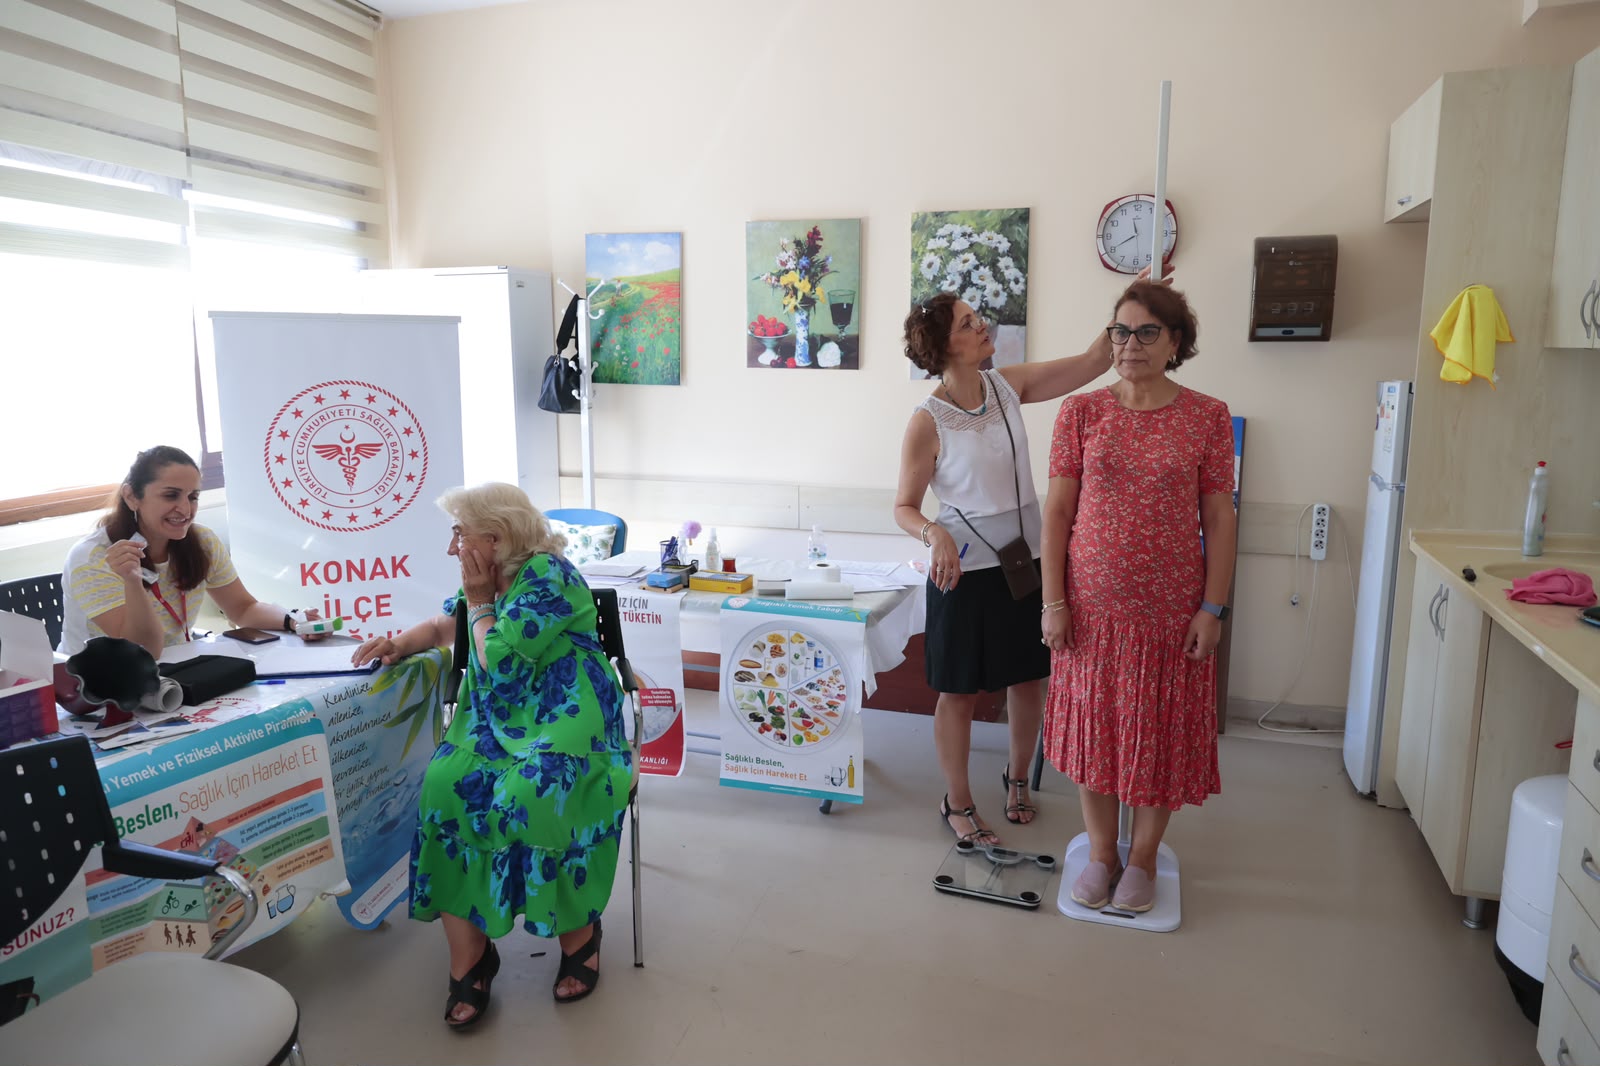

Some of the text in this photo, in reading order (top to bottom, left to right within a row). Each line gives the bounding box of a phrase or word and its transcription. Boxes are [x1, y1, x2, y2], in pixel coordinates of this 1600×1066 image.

[1133, 204, 1142, 212] 12
[1110, 246, 1116, 254] 8
[1146, 254, 1152, 262] 5
[1133, 258, 1139, 266] 6
[296, 408, 400, 499] TÜRKİYE CUMHURİYETİ SAĞLIK BAKANLIĞI
[300, 554, 412, 587] KONAK
[323, 593, 393, 623] İLÇE
[629, 596, 649, 611] İÇİN
[622, 610, 662, 625] TÜKETİN
[322, 682, 373, 709] Kendinize,
[328, 705, 364, 728] ailenize,
[109, 766, 157, 790] Yemek
[159, 760, 175, 773] ve
[175, 742, 223, 767] Fiziksel
[223, 728, 265, 752] Aktivite
[331, 741, 368, 766] ülkenize,
[640, 756, 669, 765] KANLIĞI
[725, 753, 785, 769] Sağlıklı Beslen,
[725, 763, 807, 781] Sağlık İçin Hareket Et
[114, 802, 179, 838] Beslen,
[179, 778, 225, 814] Sağlık
[226, 774, 250, 798] İçin
[252, 753, 300, 785] Hareket
[303, 745, 319, 765] Et
[2, 907, 75, 956] SUNUZ?
